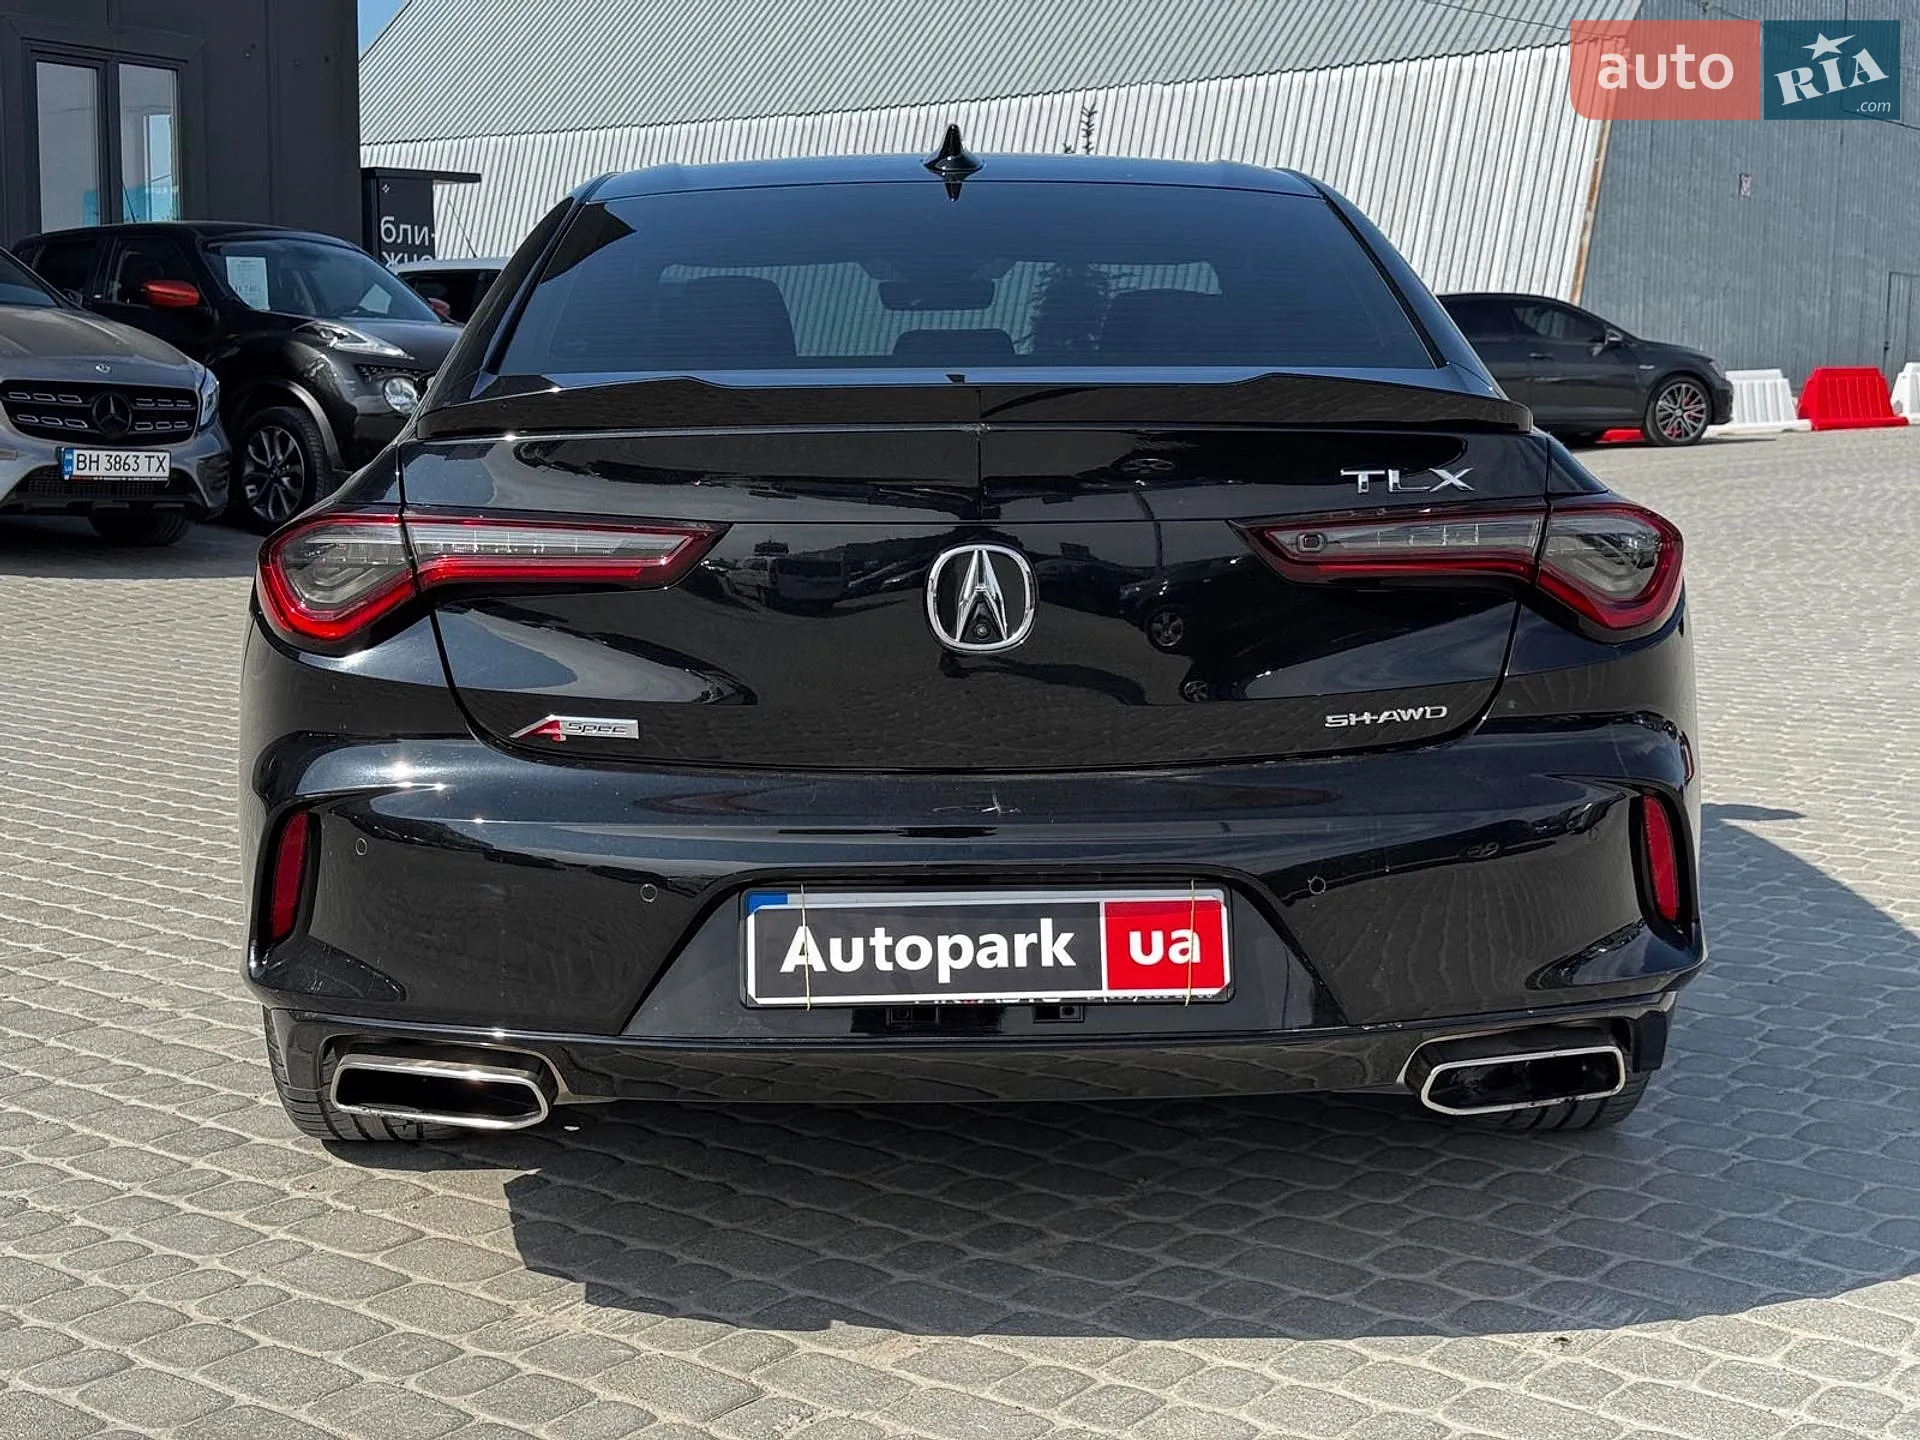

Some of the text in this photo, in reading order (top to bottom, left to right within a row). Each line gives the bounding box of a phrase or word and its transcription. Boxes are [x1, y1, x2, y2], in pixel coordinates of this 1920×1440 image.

[76, 453, 167, 473] BH 3863 TX
[1340, 467, 1475, 493] TLX
[1324, 705, 1448, 728] SH-AWD
[779, 918, 1201, 984] Autopark ua
